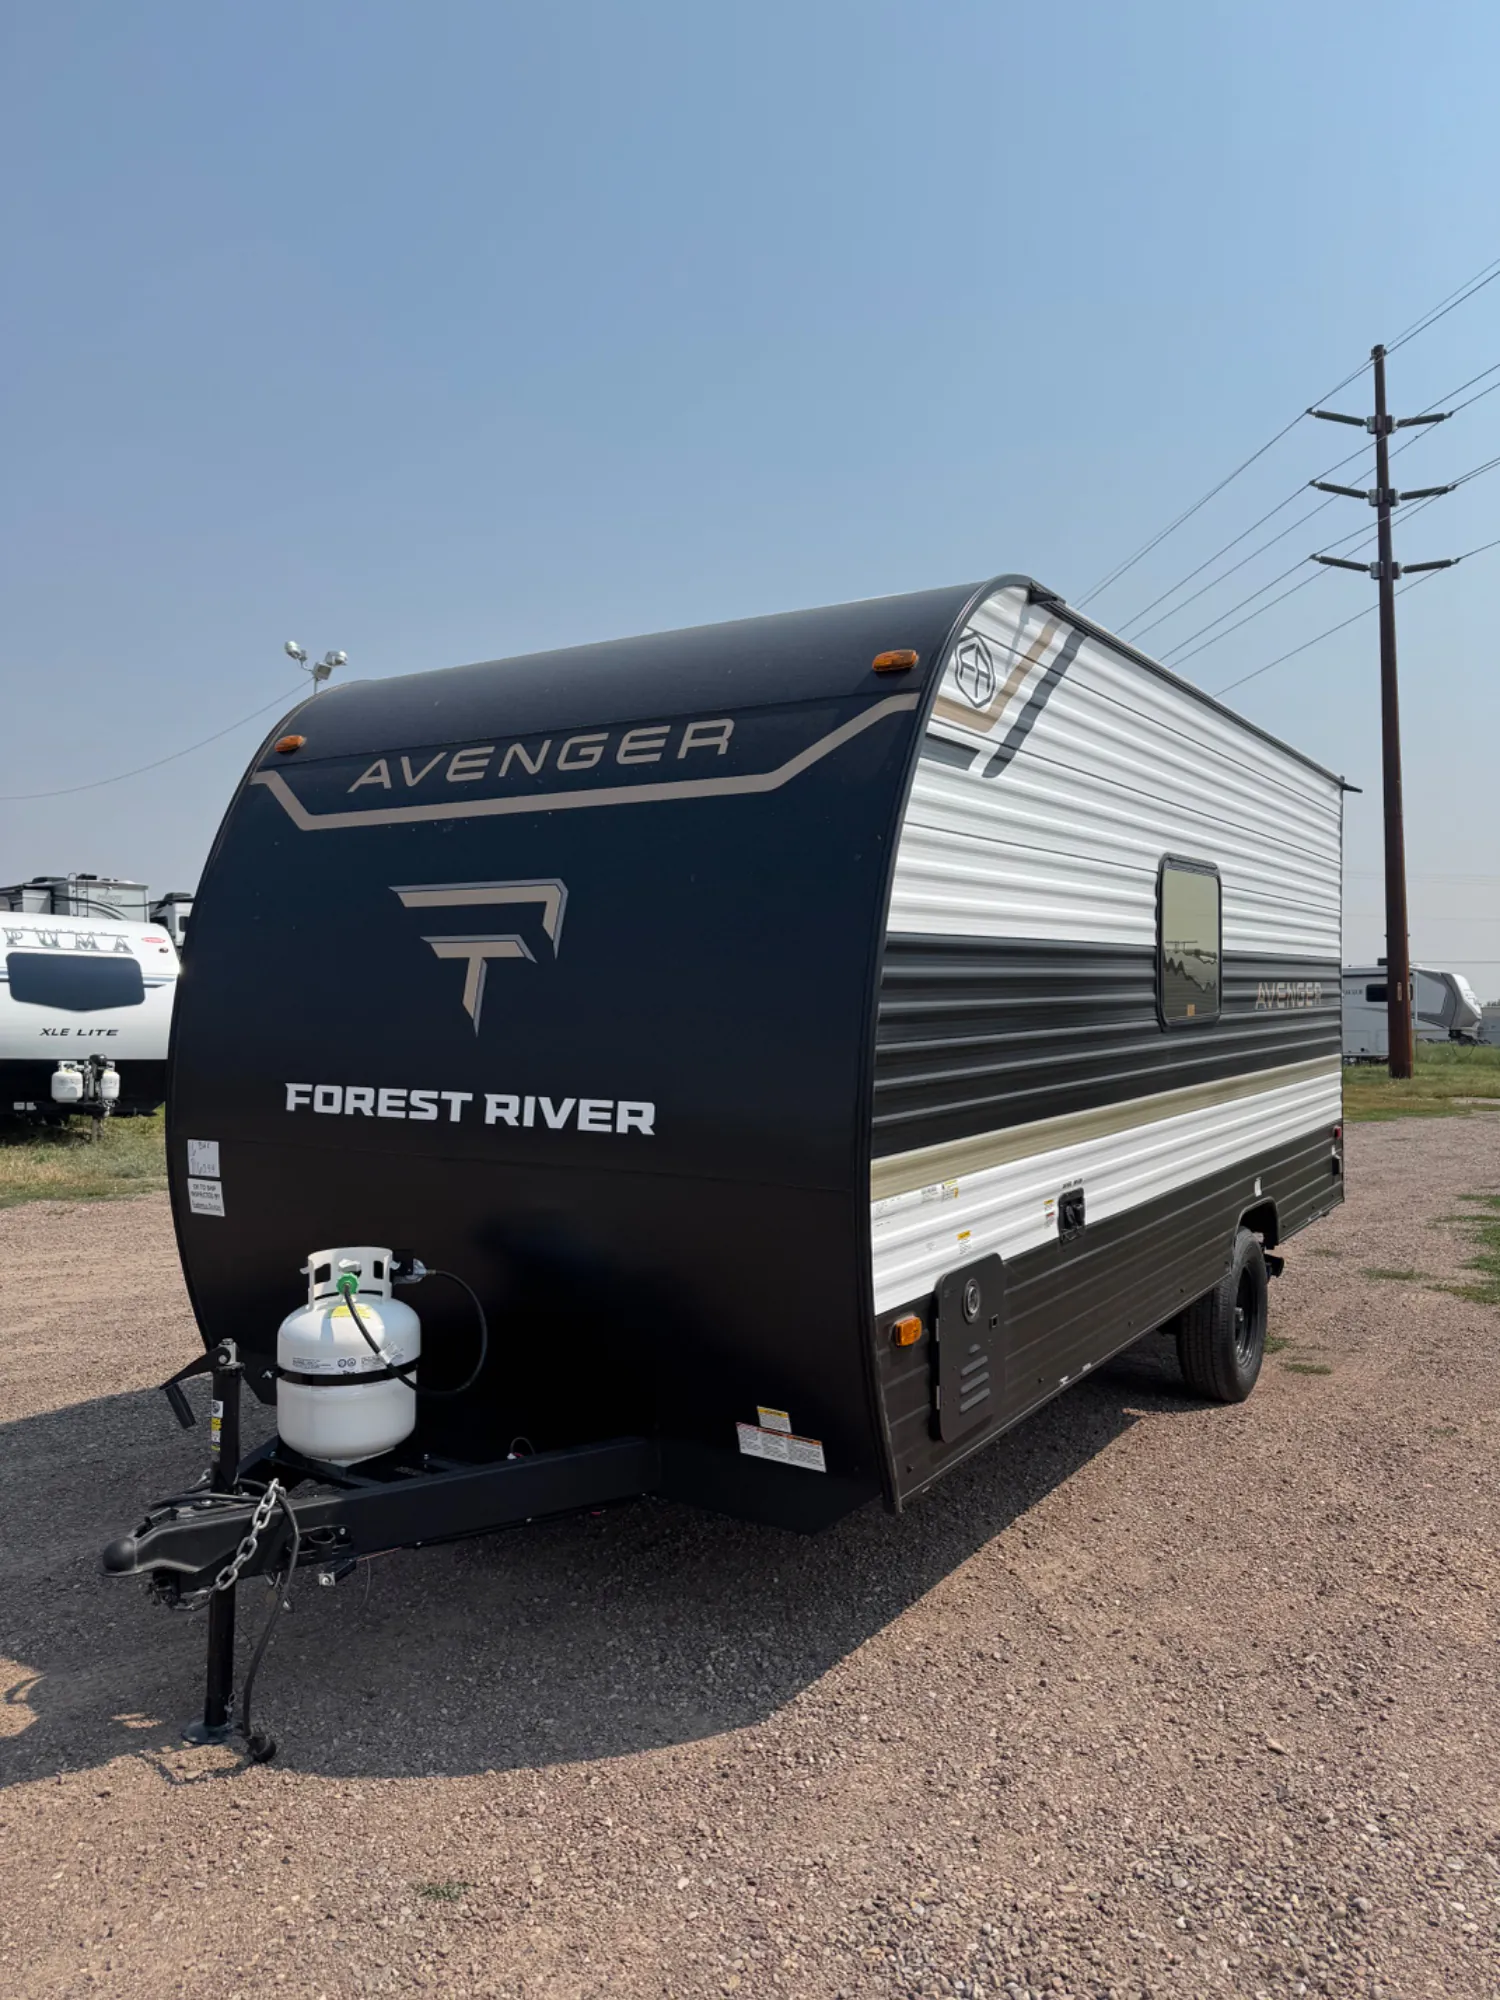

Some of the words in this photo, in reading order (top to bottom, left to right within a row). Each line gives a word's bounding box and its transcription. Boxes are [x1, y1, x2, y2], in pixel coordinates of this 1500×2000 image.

[347, 718, 735, 794] AVENGER
[3, 928, 133, 954] PUMA
[1255, 982, 1321, 1010] AVENGER
[39, 1028, 70, 1037] XLE
[76, 1029, 119, 1037] LITE
[285, 1083, 473, 1122] FOREST
[484, 1093, 655, 1135] RIVER
